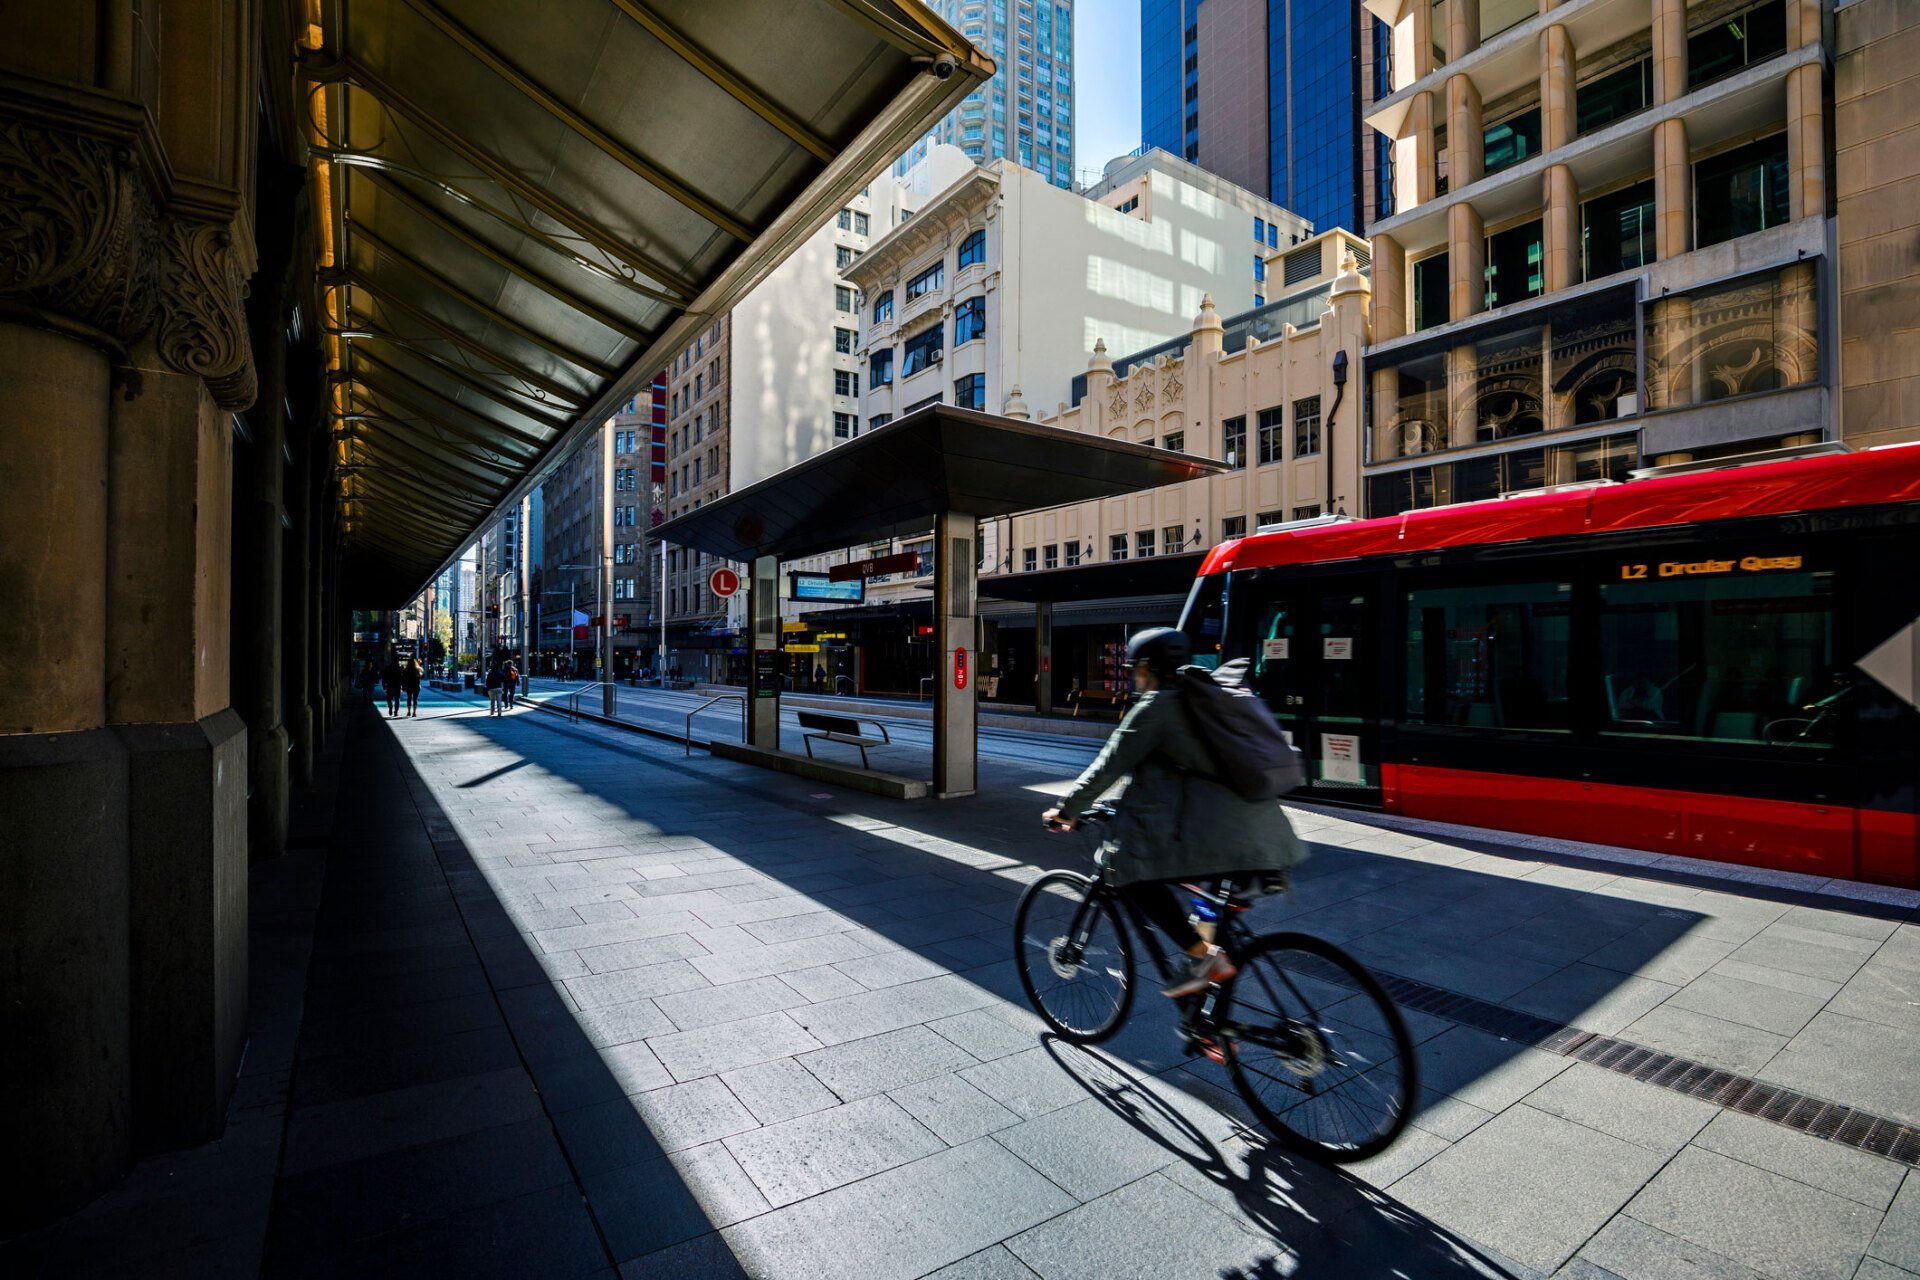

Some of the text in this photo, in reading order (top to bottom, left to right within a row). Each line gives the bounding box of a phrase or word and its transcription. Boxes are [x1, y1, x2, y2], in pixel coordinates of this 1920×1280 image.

[862, 562, 874, 574] QVB
[1621, 555, 1803, 580] L2 Circular Quay
[720, 574, 731, 591] L
